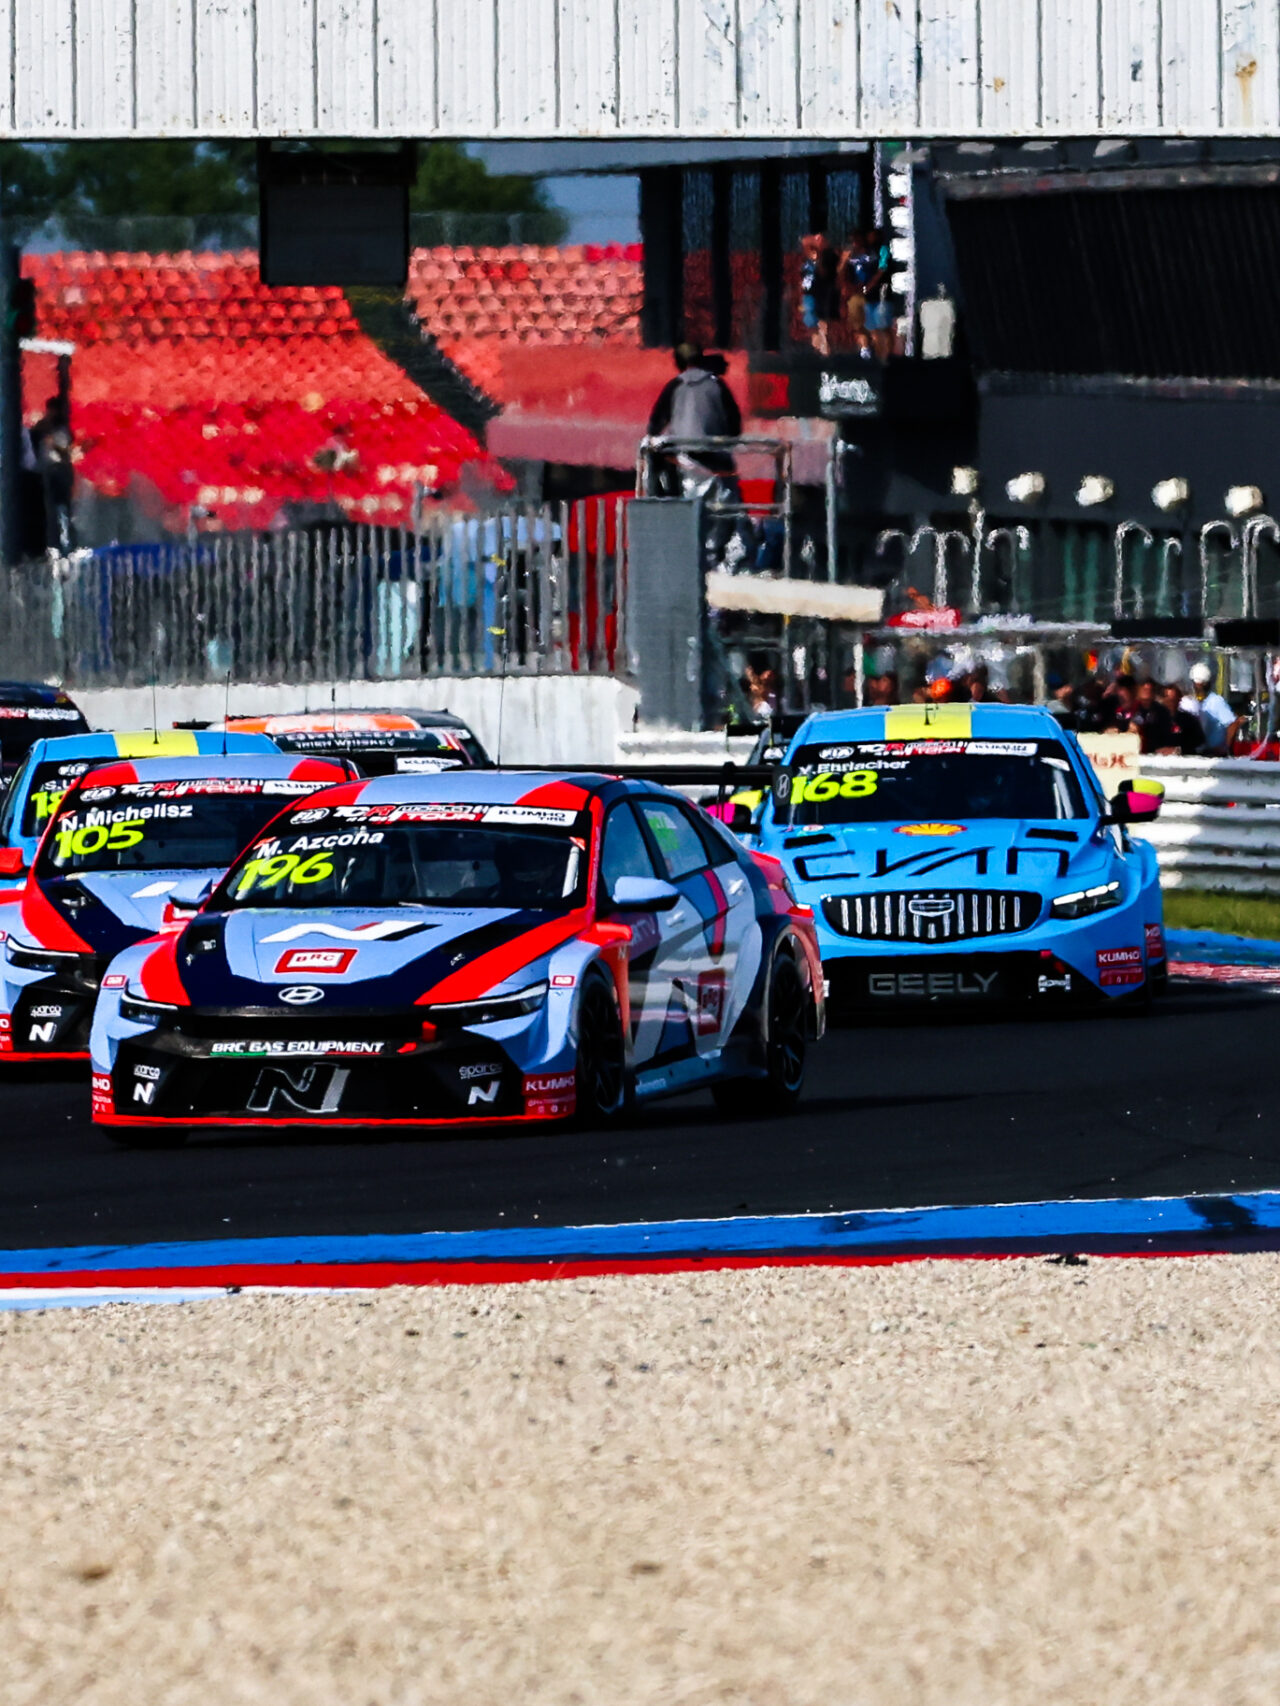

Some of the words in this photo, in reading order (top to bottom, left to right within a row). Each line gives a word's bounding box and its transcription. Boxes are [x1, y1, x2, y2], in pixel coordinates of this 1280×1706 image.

[819, 745, 855, 760] FIA
[791, 769, 879, 805] 168
[290, 808, 330, 824] FIA
[406, 812, 477, 821] TOUR
[497, 808, 567, 819] KUMHO
[55, 819, 145, 858] 105
[287, 830, 385, 853] Azcona
[236, 851, 334, 891] 196
[295, 953, 336, 964] BRC
[1097, 949, 1141, 964] KUMHO
[868, 971, 999, 996] GEELY
[211, 1041, 245, 1053] BRC
[248, 1041, 284, 1053] GAS
[286, 1041, 385, 1053] EQUIPMENT
